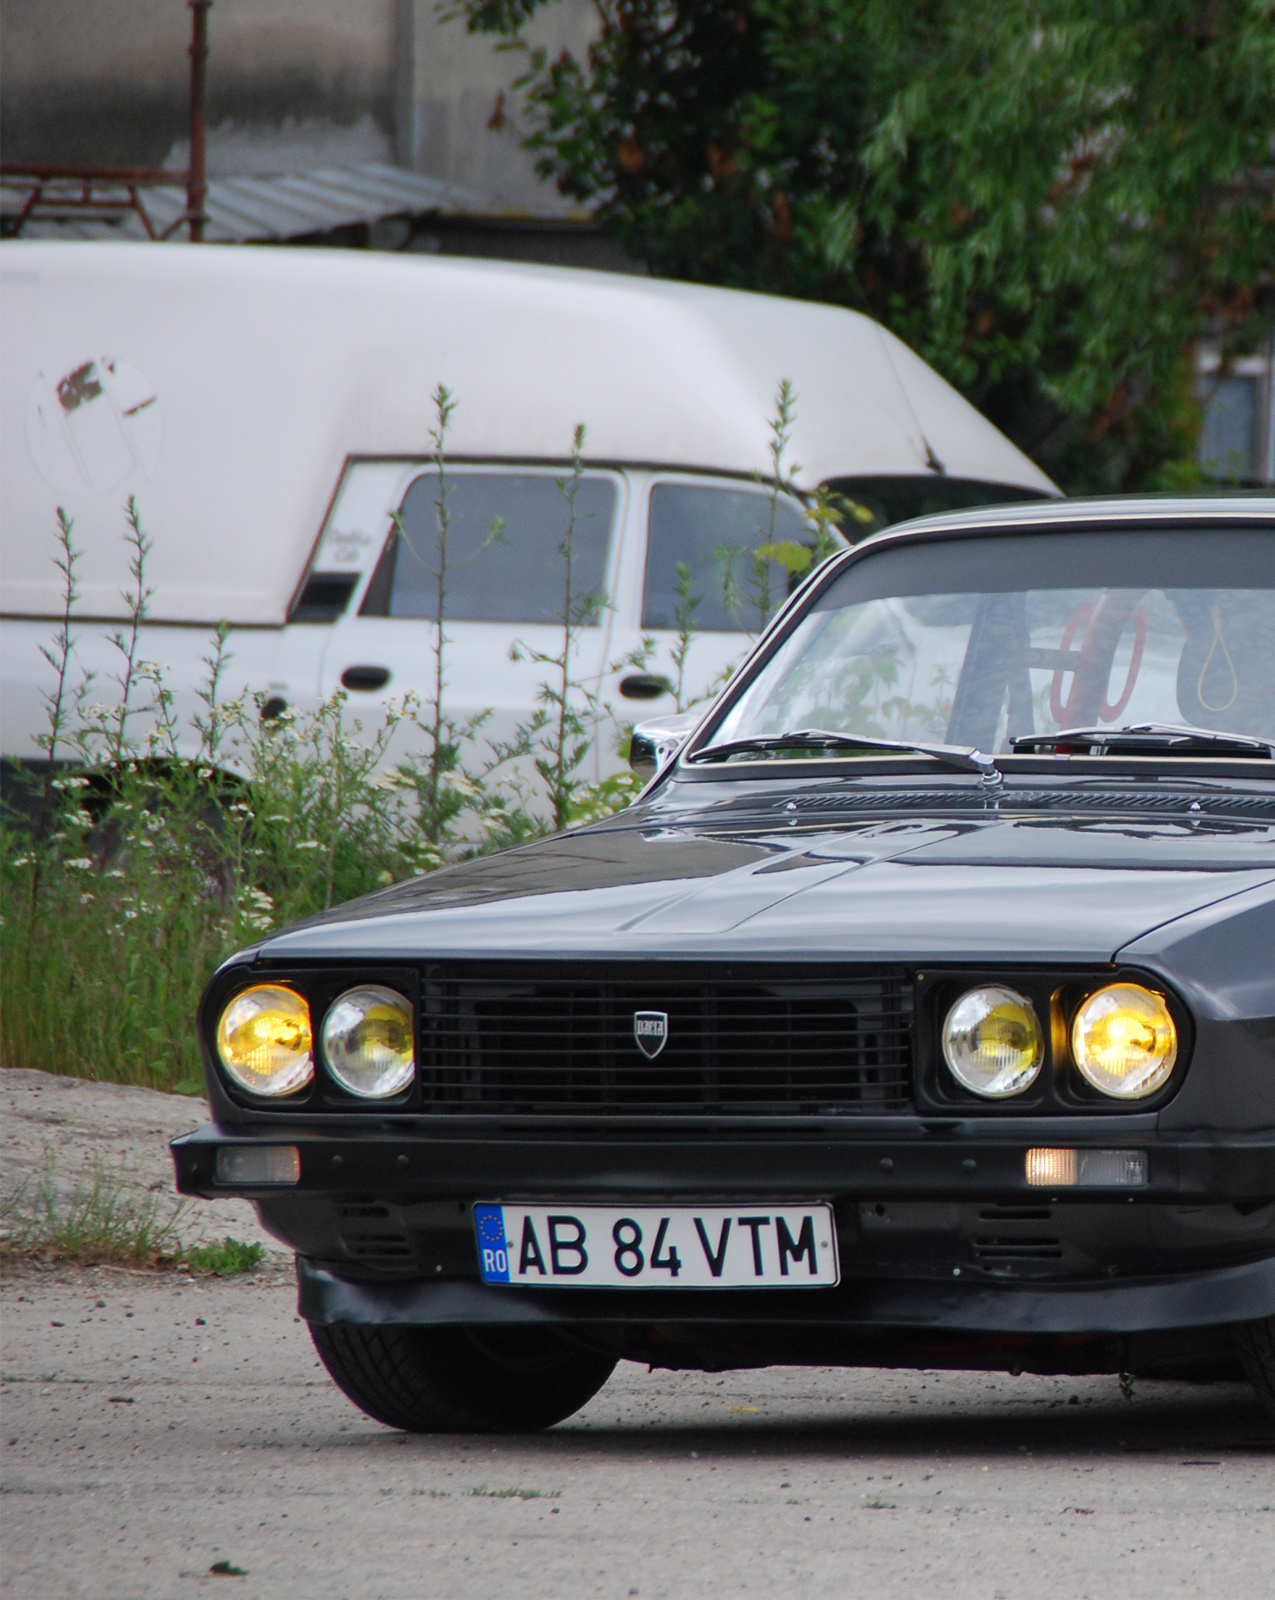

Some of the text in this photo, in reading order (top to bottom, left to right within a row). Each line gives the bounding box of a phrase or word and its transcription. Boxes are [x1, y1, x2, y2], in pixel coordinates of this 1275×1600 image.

[483, 1248, 507, 1273] RO
[518, 1215, 818, 1277] AB 84 VTM
